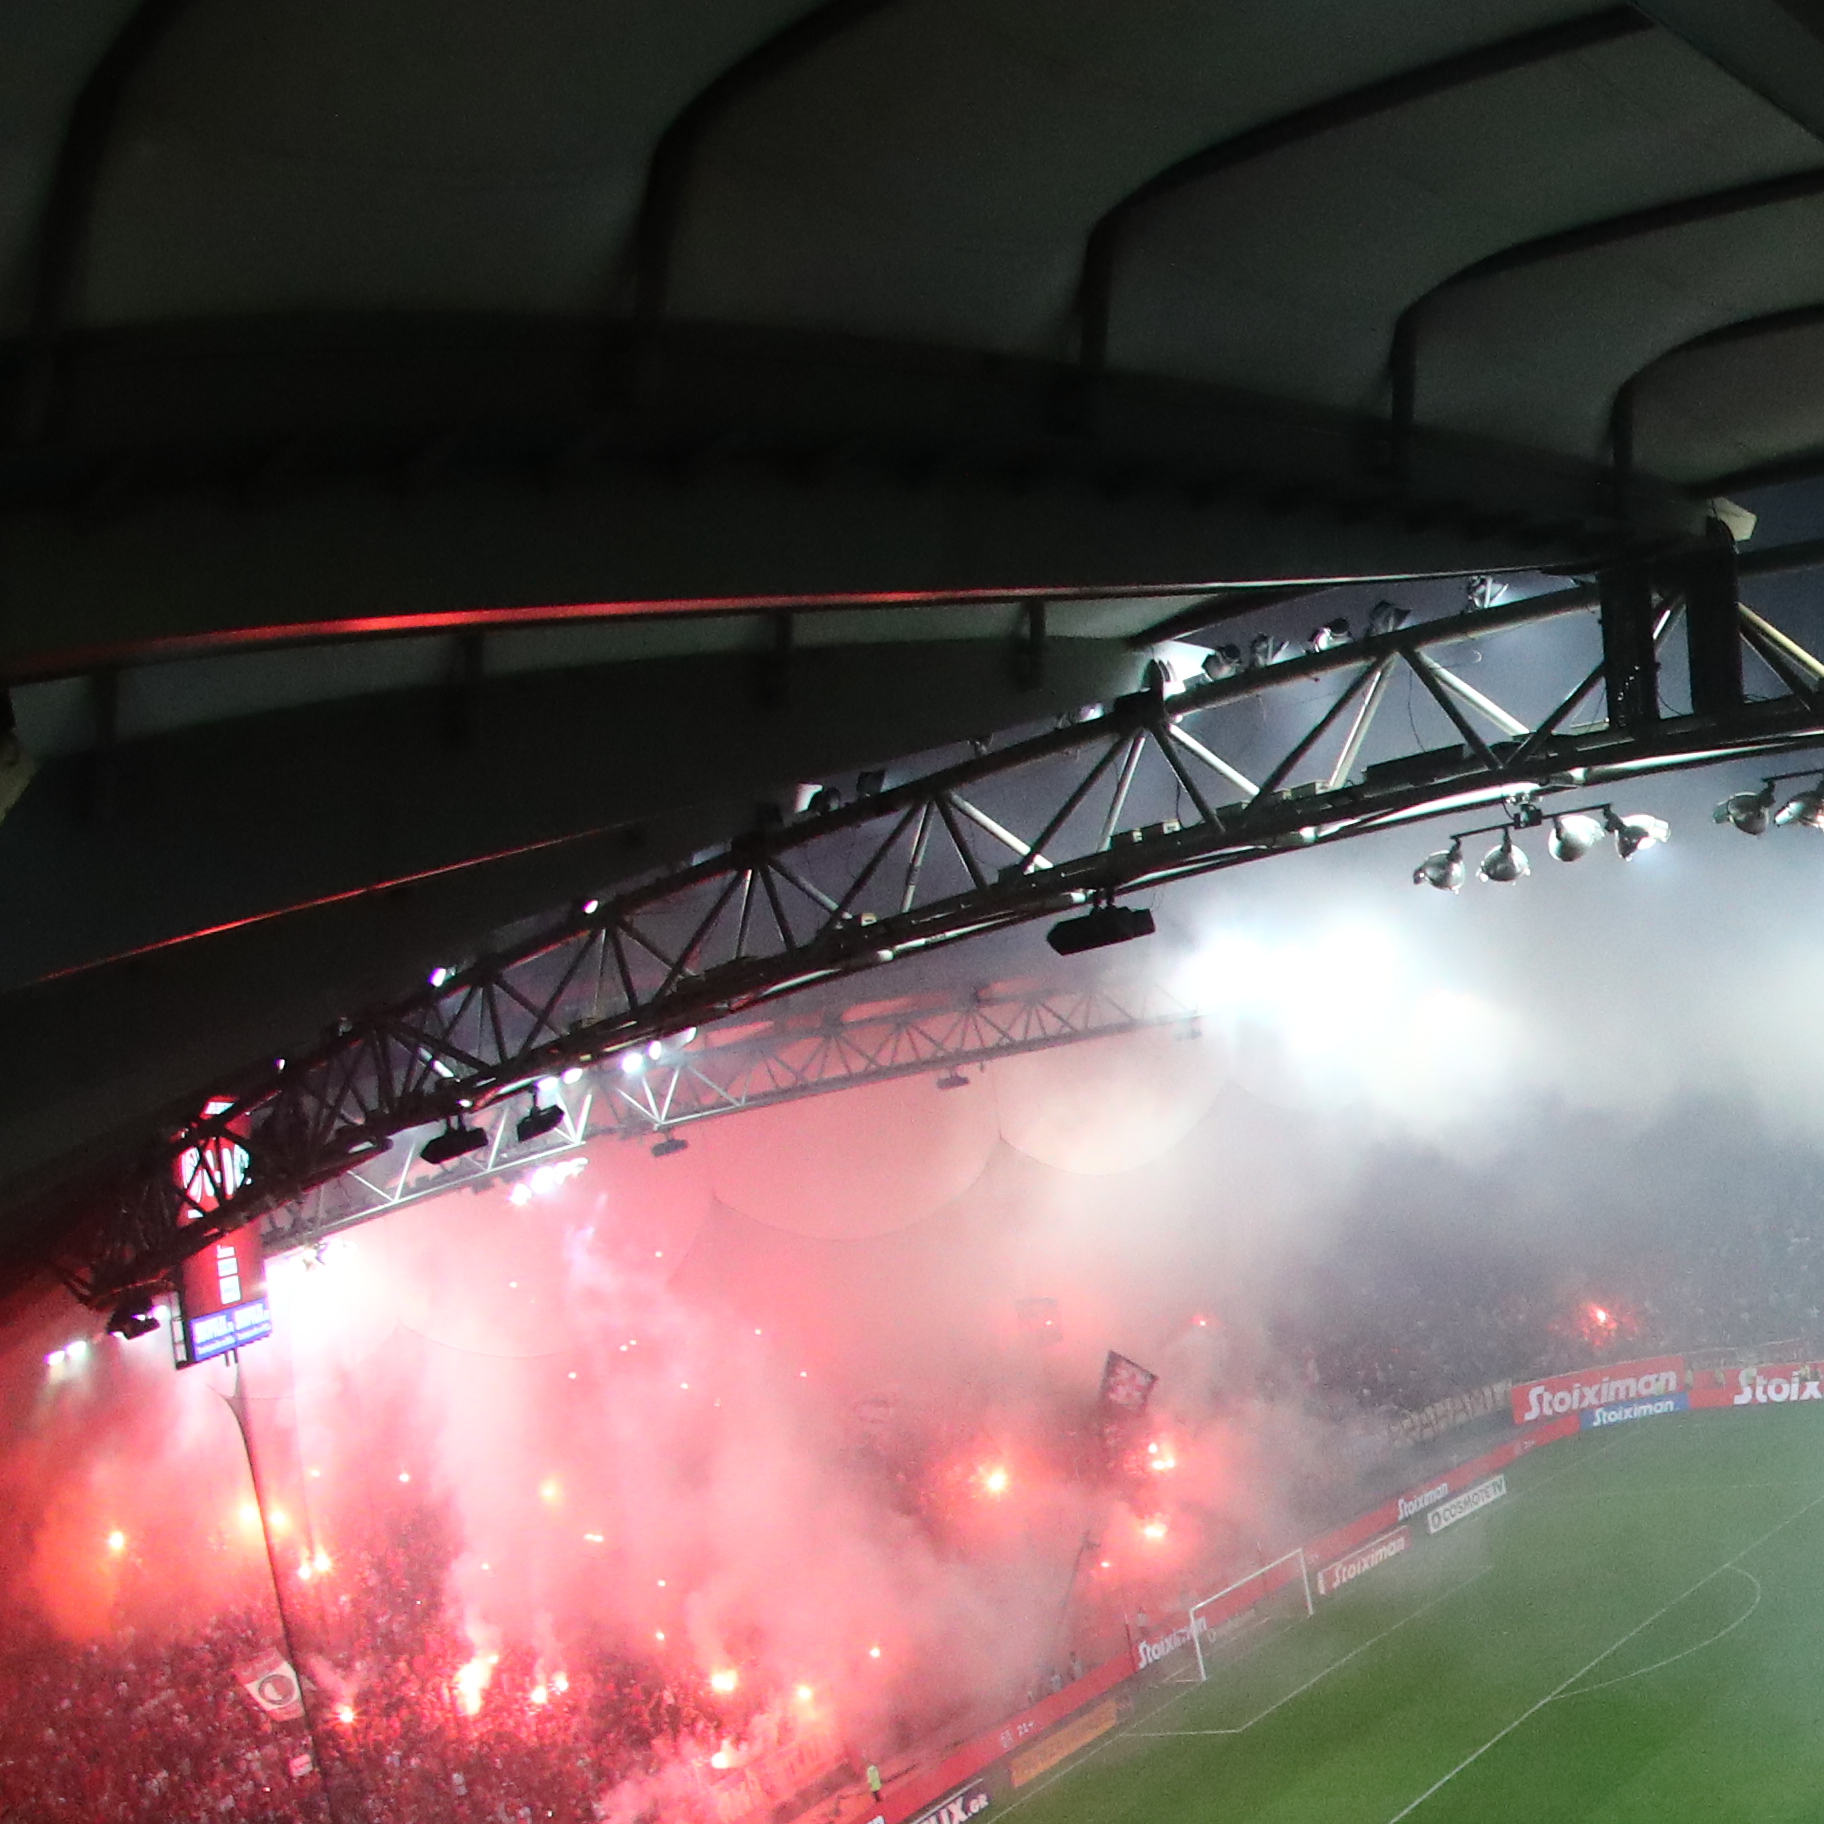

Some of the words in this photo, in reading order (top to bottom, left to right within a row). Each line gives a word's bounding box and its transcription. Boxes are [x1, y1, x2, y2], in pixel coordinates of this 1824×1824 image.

[1524, 1371, 1677, 1421] Stoiximan
[1593, 1400, 1675, 1426] Stoiximan
[1398, 1483, 1448, 1522] Stoiximan
[1443, 1486, 1491, 1523] COSMOTE
